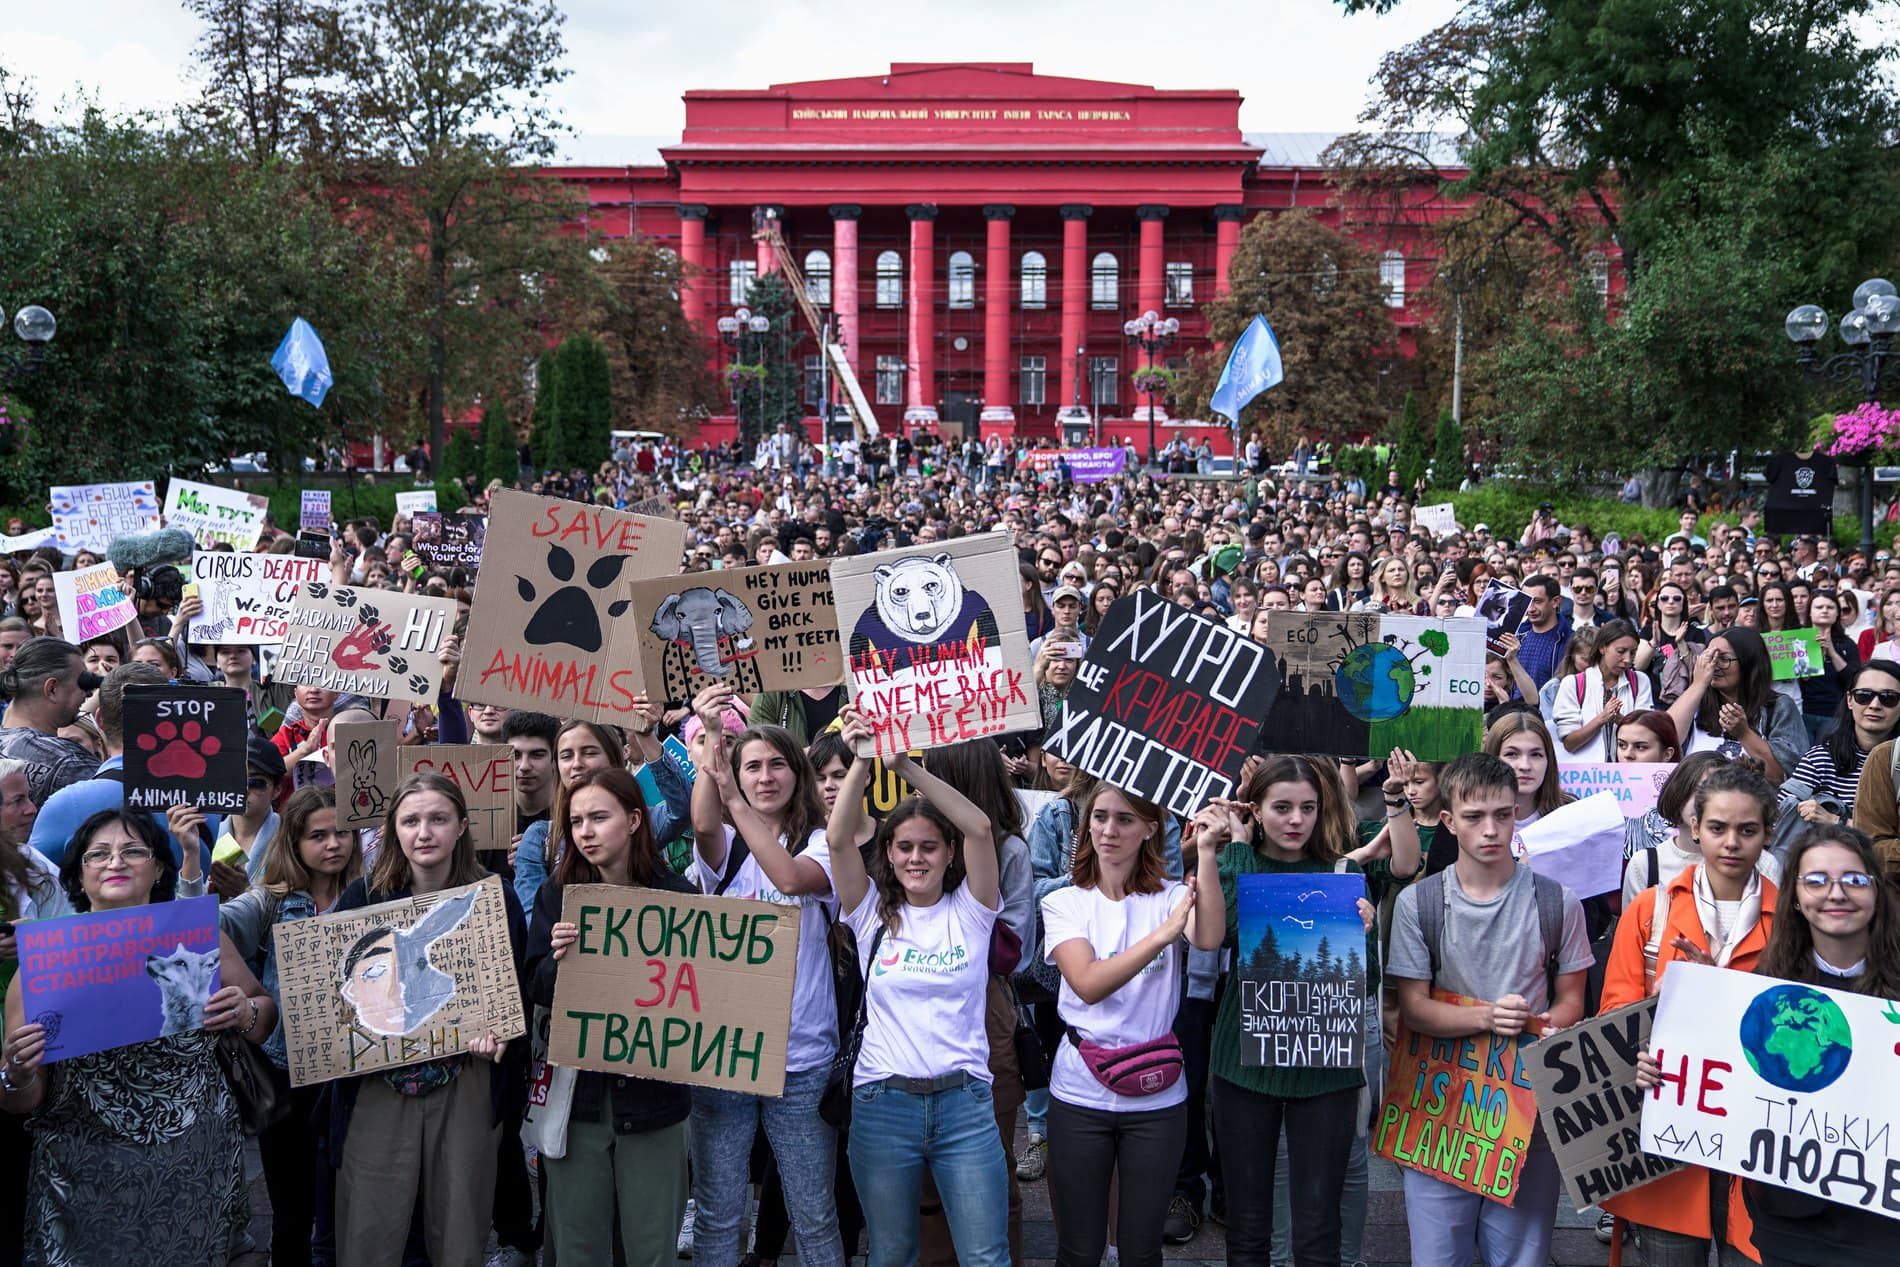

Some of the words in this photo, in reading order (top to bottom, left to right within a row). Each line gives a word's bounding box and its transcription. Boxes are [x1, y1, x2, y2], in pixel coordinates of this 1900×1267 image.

[531, 506, 647, 551] SAVE
[417, 542, 439, 552] Who
[441, 543, 462, 553] Died
[430, 551, 456, 562] Your
[458, 552, 480, 563] Coa
[195, 555, 253, 579] CIRCUS
[262, 559, 321, 582] DEATH
[745, 572, 780, 590] HEY
[787, 568, 832, 588] HUMA
[234, 596, 262, 613] We
[263, 606, 290, 619] are
[275, 580, 299, 604] CA
[812, 590, 836, 606] ME
[290, 607, 356, 634] НАСИЛЛЮ
[768, 611, 814, 631] BACK
[1286, 628, 1320, 645] EGO
[281, 632, 332, 665] НАД
[764, 634, 789, 650] MY
[1107, 590, 1265, 709] ХУТРО
[278, 658, 390, 696] ТВАРИНАМИ
[782, 650, 802, 673] !!!
[850, 648, 897, 685] HEY
[953, 667, 1028, 708] BACK
[1449, 679, 1481, 696] ECO
[157, 700, 216, 724] STOP
[1076, 659, 1110, 693] ЦЕ
[1102, 664, 1260, 779] КРИВАВЕ
[871, 712, 912, 756] MY
[1041, 699, 1234, 822] ЖЛОБСТВО
[1559, 767, 1624, 785] КРАЇНА
[128, 787, 192, 808] ANIMAL
[196, 791, 245, 808] ABUSE
[25, 929, 65, 951] МИ
[71, 915, 155, 944] ПРОТИ
[26, 925, 215, 973] ПРИТРАВОЧНИХ
[579, 904, 779, 965] ЕКОКЛУБ
[634, 958, 701, 1014] ЗА
[1242, 980, 1310, 1014] СКОРО
[1311, 980, 1356, 998] ЛИШЕ
[1242, 1014, 1320, 1033] ЗНАТИМУТЬ
[1326, 1016, 1358, 1034] ЦИХ
[566, 1010, 764, 1082] ТВАРИН
[1252, 1033, 1352, 1067] ТВАРИН
[1543, 1007, 1657, 1095] SAV
[1653, 1048, 1733, 1118] НЕ
[1458, 1079, 1508, 1141] NO
[1376, 1103, 1495, 1187] PLANET
[1605, 1126, 1641, 1163] SA
[1653, 1124, 1723, 1161] ДЛЯ
[1741, 1127, 1900, 1213] ЛЮДЕ
